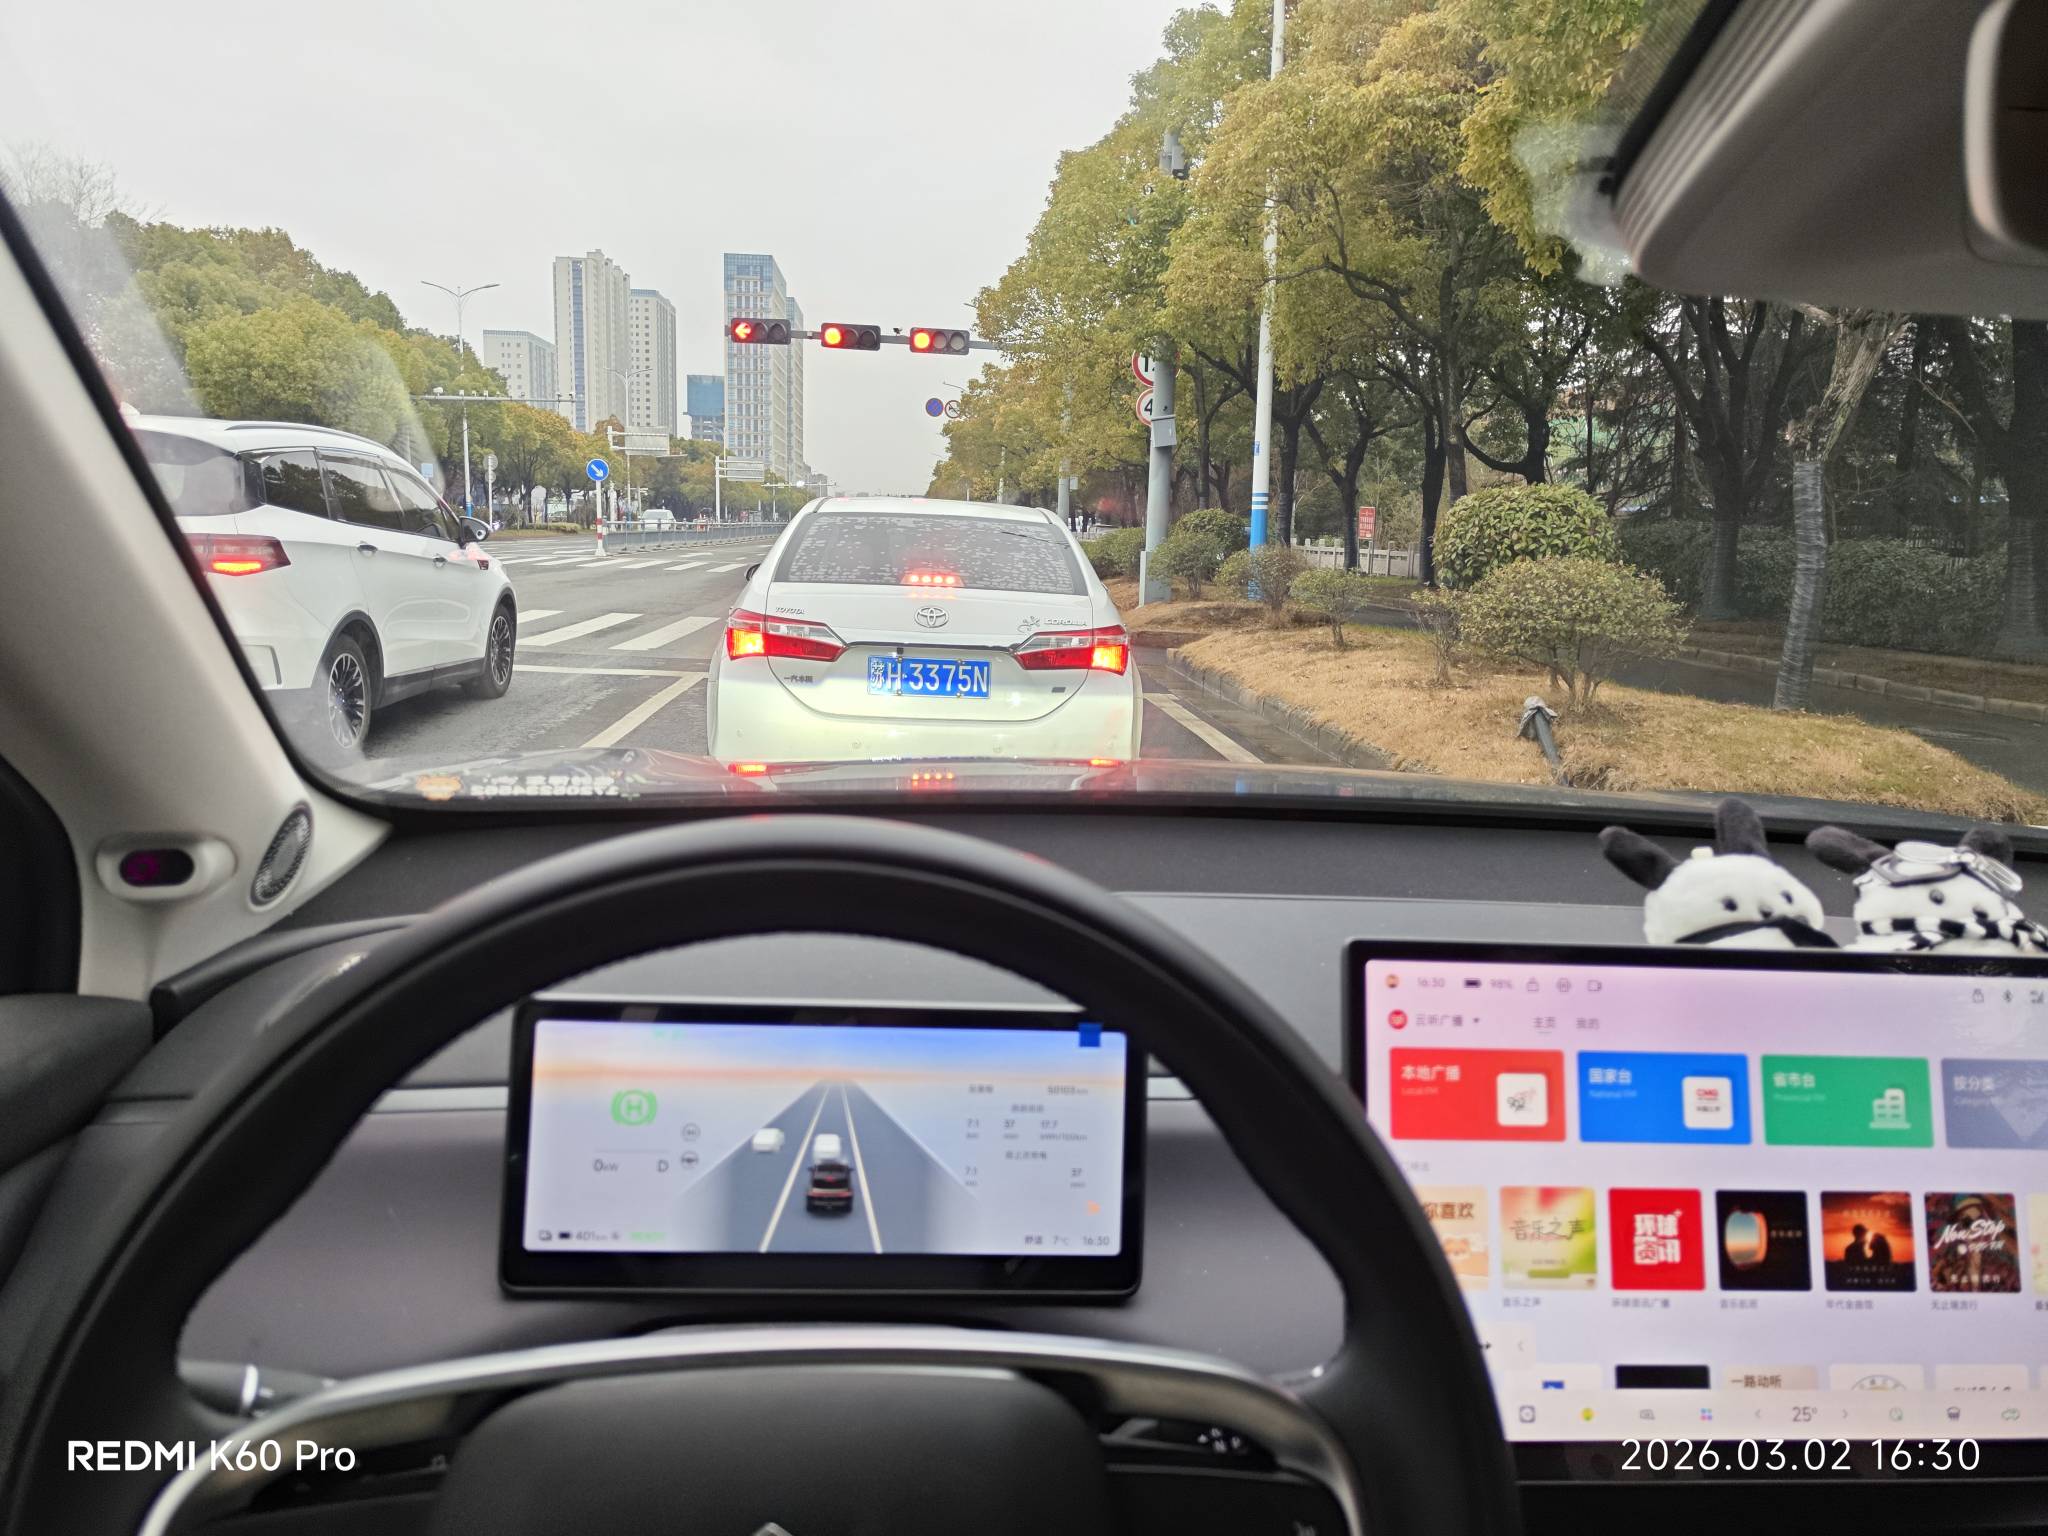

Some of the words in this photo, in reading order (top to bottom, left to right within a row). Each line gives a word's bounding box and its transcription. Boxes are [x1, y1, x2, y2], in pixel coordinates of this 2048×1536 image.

[775, 606, 806, 615] TOYOTA
[1401, 1064, 1461, 1082] 本地广播
[1508, 1216, 1585, 1241] 音乐之声
[1730, 1374, 1782, 1389] 一路动听
